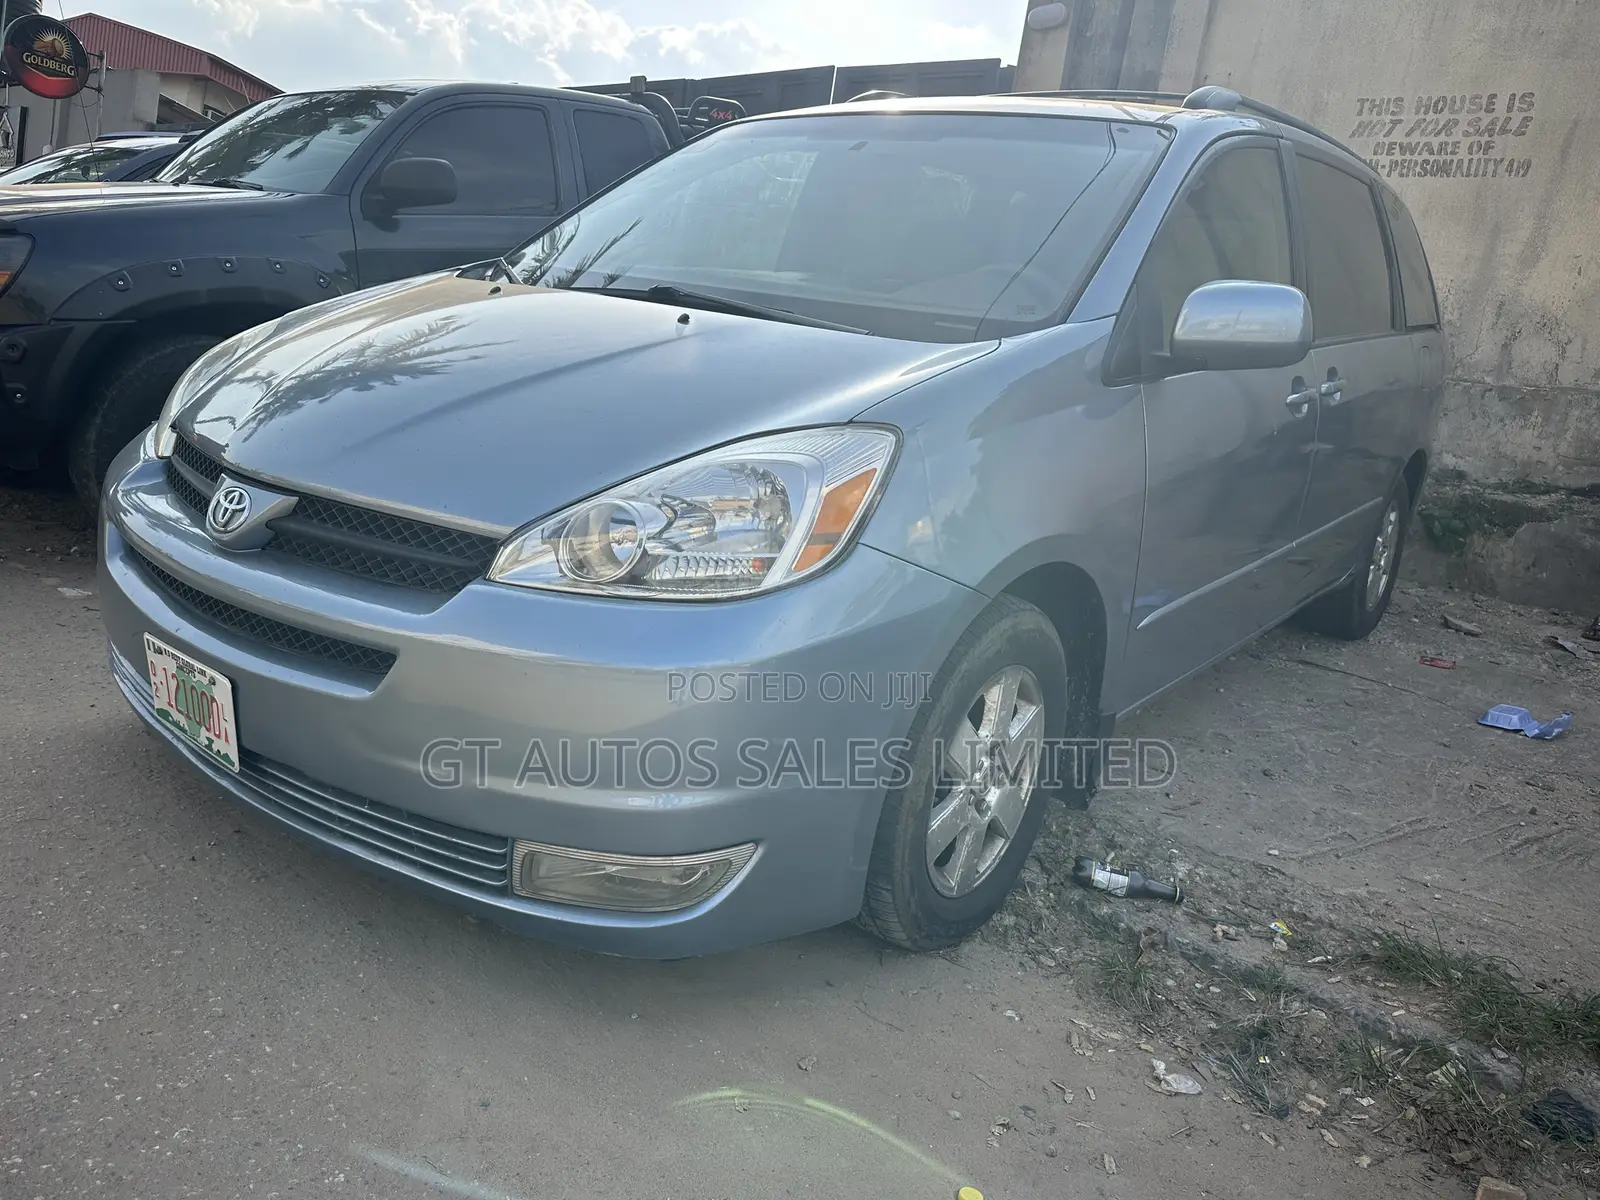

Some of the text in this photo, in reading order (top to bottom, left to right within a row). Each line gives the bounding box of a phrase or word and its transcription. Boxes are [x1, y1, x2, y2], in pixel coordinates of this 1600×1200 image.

[23, 52, 75, 76] GOLDBERG
[1356, 92, 1535, 117] THIS HOUSE IS
[1349, 116, 1534, 139] NOT FOR SALE
[1372, 140, 1496, 156] BEWARE OF
[1505, 158, 1532, 178] 419
